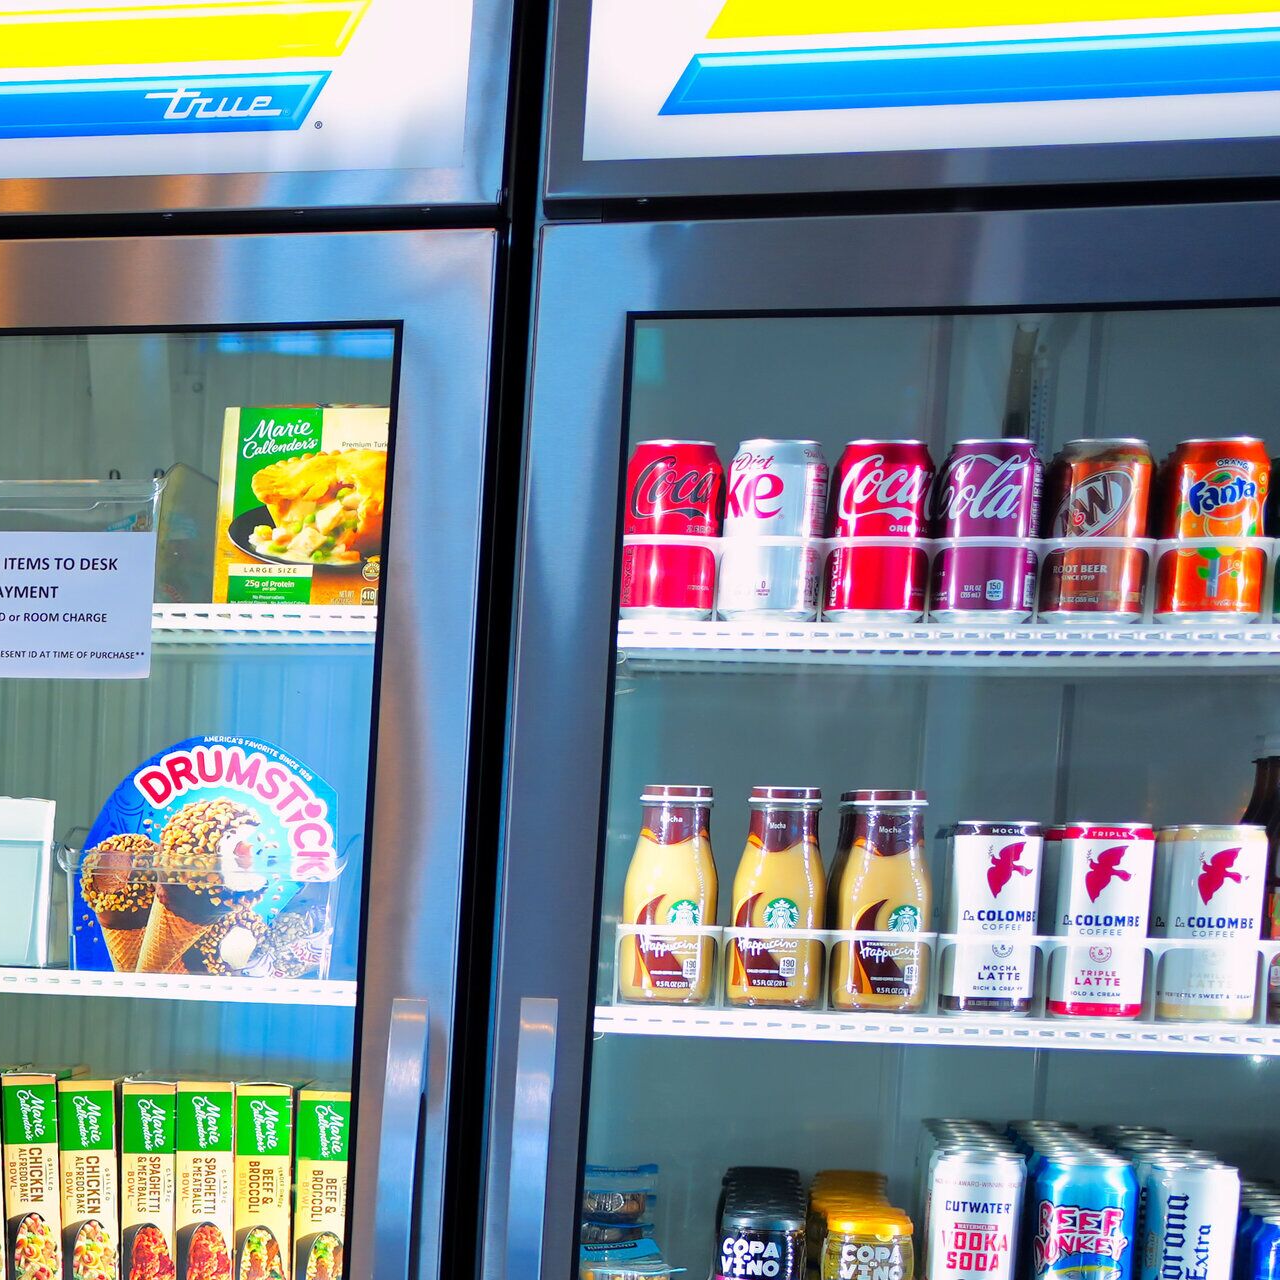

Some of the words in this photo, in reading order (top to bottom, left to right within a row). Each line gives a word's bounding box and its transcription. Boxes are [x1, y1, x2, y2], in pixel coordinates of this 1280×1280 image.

[145, 86, 283, 122] true
[244, 419, 313, 442] Marie
[242, 438, 318, 459] Callender's
[735, 452, 775, 472] Diet
[1189, 476, 1257, 516] Fanta
[4, 557, 50, 571] ITEMS
[54, 557, 75, 571] TO
[80, 558, 118, 571] DESK
[1053, 565, 1077, 573] ROOT
[1080, 564, 1108, 573] BEER
[245, 580, 260, 589] 25g
[270, 580, 295, 588] Protein
[9, 614, 20, 622] or
[24, 612, 59, 623] ROOM
[62, 613, 107, 623] CHARGE
[28, 650, 37, 659] ID
[39, 651, 50, 659] AT
[52, 651, 74, 659] TIME
[76, 651, 88, 659] OF
[204, 735, 244, 745] AMERICA'S
[244, 740, 278, 758] FAVORITE
[279, 753, 300, 771] SINCE
[299, 767, 313, 782] 1928
[140, 750, 330, 875] DRUMSTICK
[879, 826, 901, 834] Mocha
[977, 910, 1036, 922] COLOMBE
[977, 972, 1020, 981] LATTE
[149, 1156, 161, 1214] SPAGHETTI
[248, 1161, 260, 1214] BROCCOLI
[262, 1169, 274, 1195] BEEF
[945, 1200, 1012, 1215] CUTWATER
[1039, 1200, 1124, 1235] REEF
[942, 1230, 1008, 1252] VODKA
[841, 1244, 901, 1263] COPA
[947, 1251, 999, 1272] SODA
[1035, 1234, 1128, 1275] DONKEY
